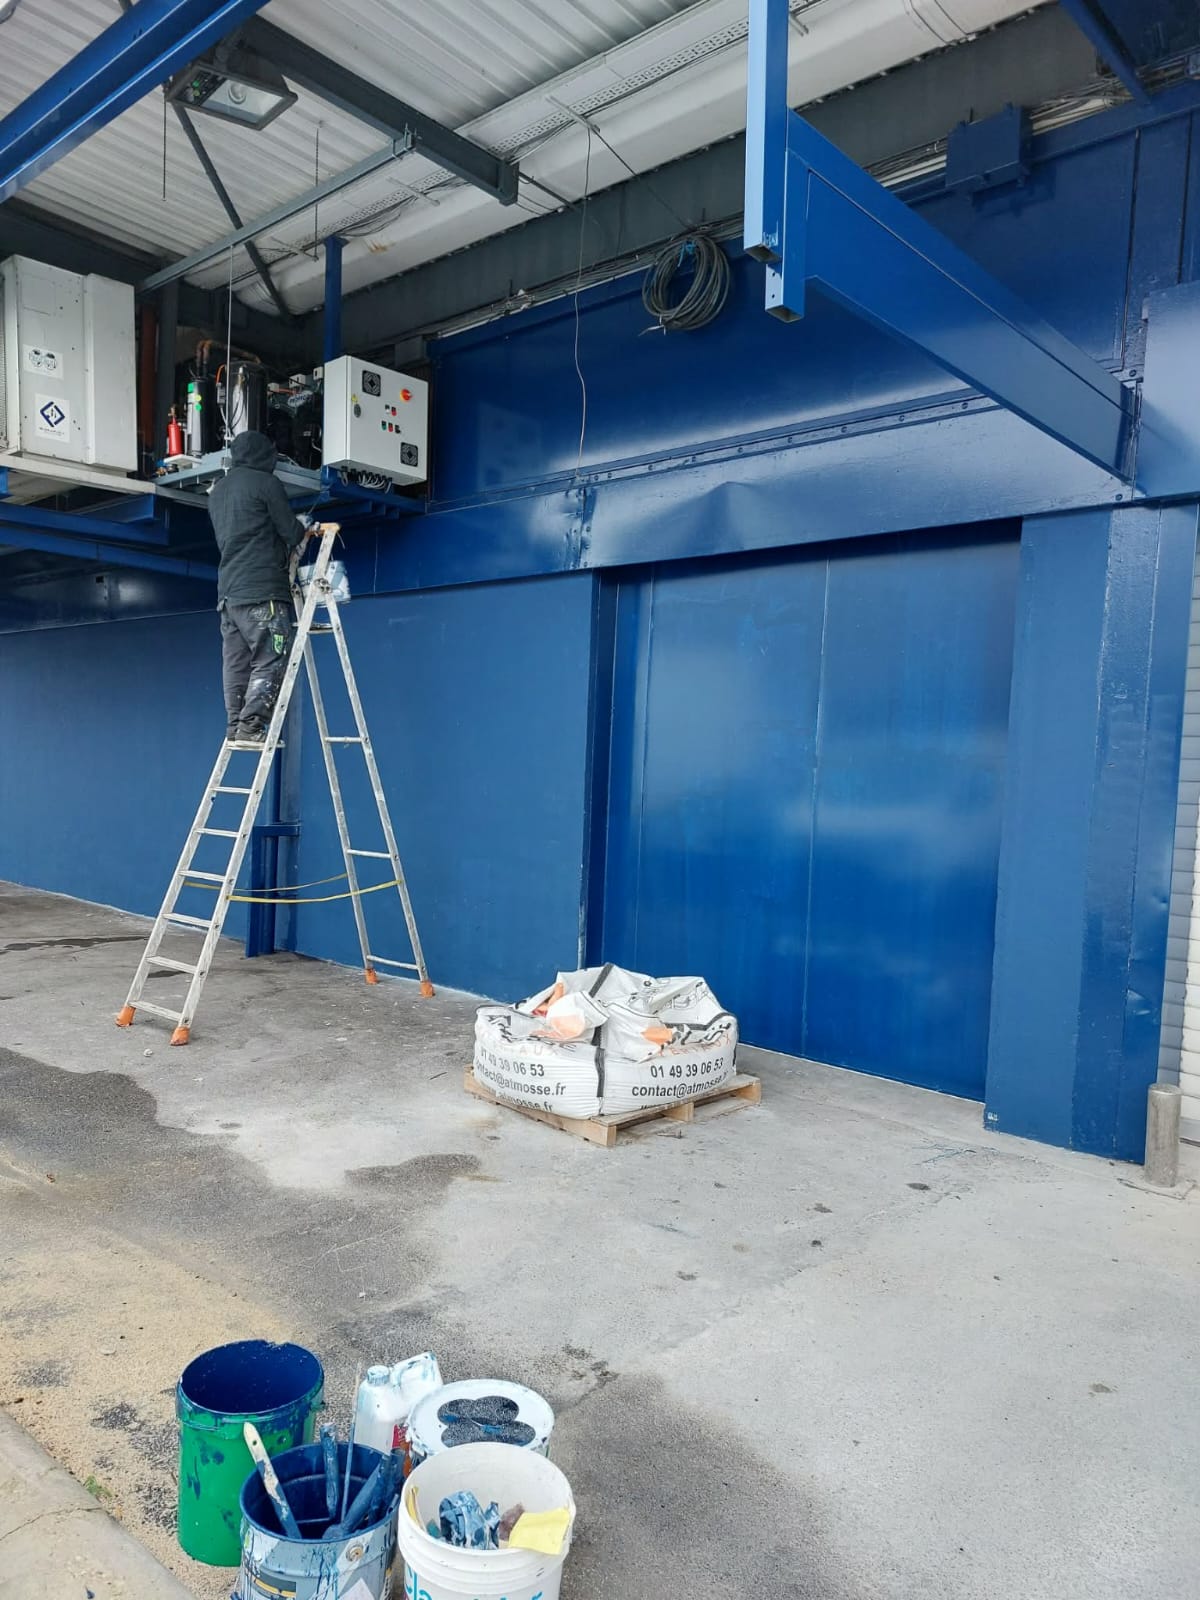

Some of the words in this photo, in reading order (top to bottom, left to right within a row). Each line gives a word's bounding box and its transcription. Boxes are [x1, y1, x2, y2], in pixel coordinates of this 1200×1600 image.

[499, 1058, 511, 1073] 39
[513, 1061, 527, 1076] 06
[530, 1064, 545, 1077] 53
[650, 1065, 665, 1079] 01
[669, 1064, 683, 1078] 49
[686, 1063, 698, 1077] 39
[701, 1062, 712, 1076] 06
[714, 1057, 724, 1071] 53
